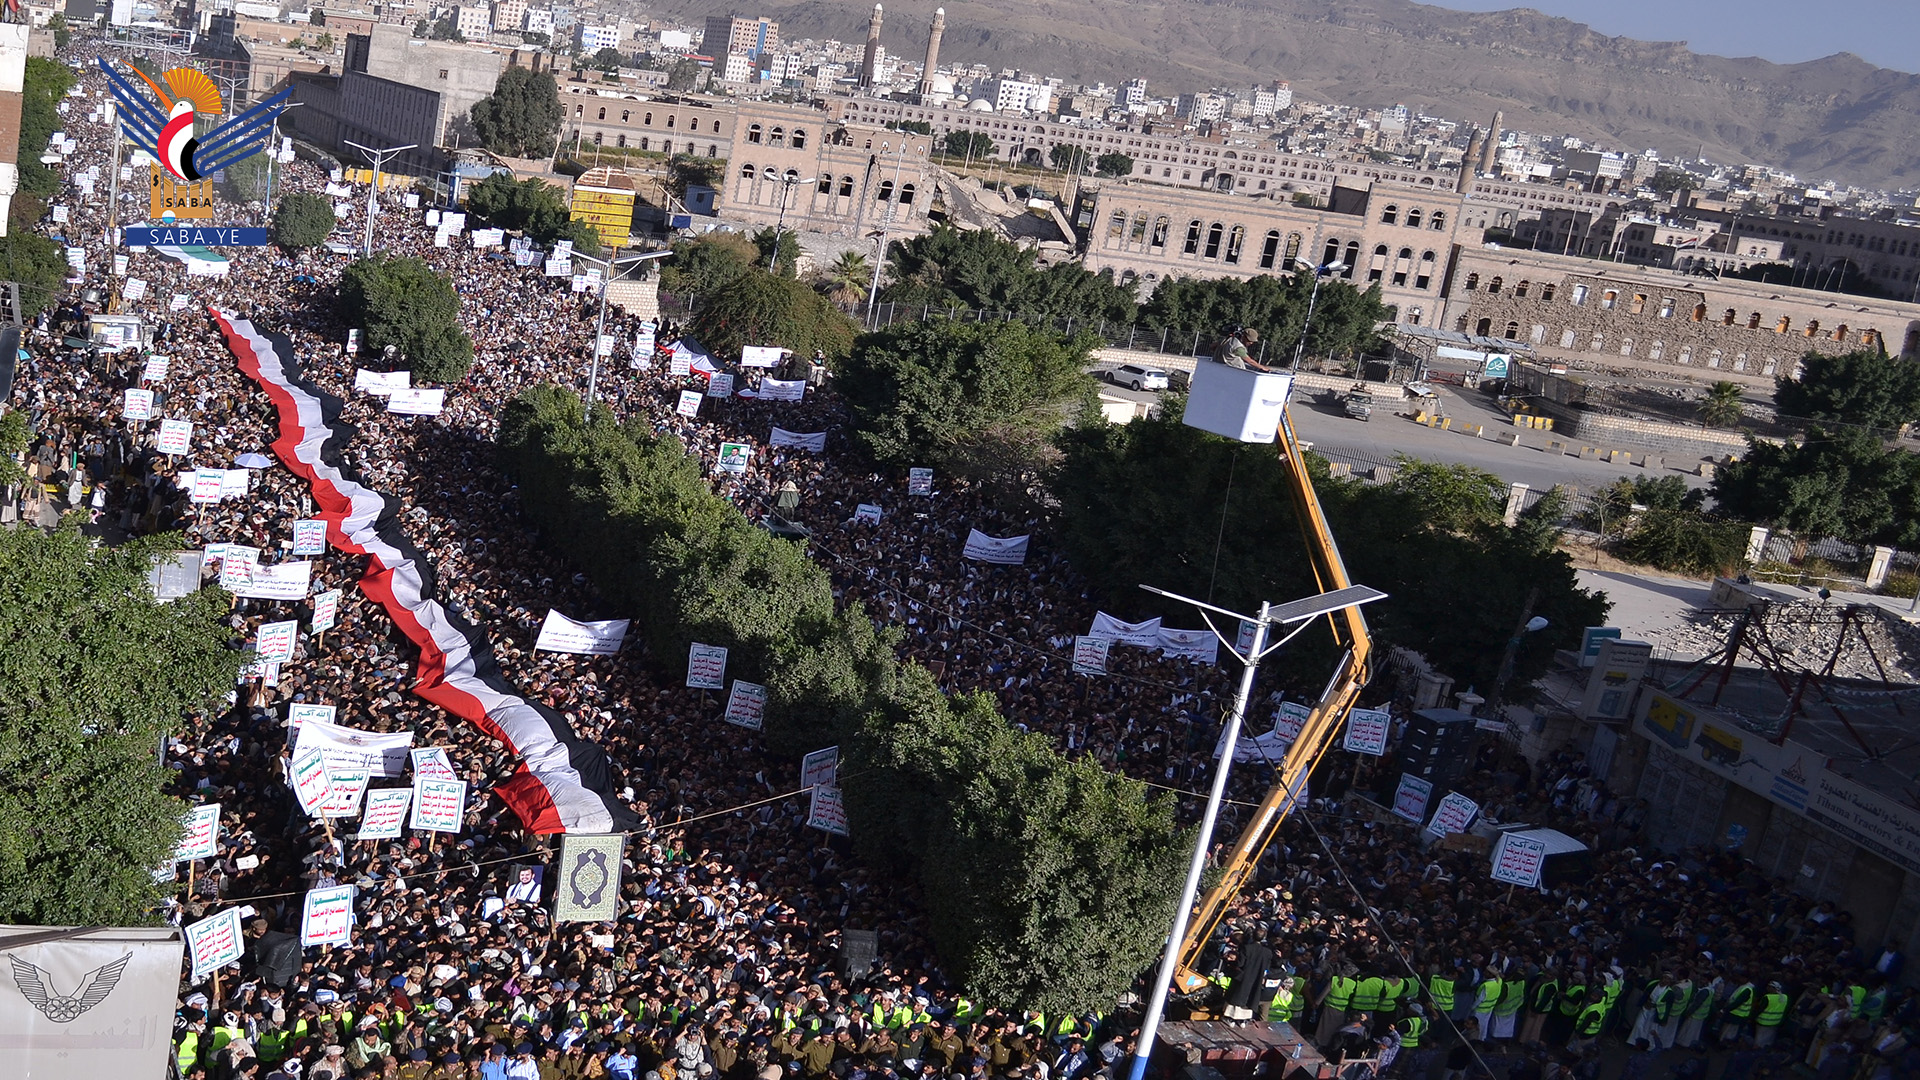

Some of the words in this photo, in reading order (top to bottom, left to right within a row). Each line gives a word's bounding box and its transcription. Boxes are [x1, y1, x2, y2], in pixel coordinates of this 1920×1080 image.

[424, 784, 445, 792] أكبر
[1819, 777, 1852, 801] المحدودة
[418, 816, 437, 825] للإسلام
[1816, 794, 1850, 820] Tihama
[1853, 811, 1892, 841] Tractors
[1507, 840, 1529, 848] أكبر
[1505, 847, 1523, 855] لأمريكا
[1502, 854, 1521, 862] لإسرائيل
[1498, 868, 1516, 878] للإسلام
[311, 890, 349, 908] قاطعوا
